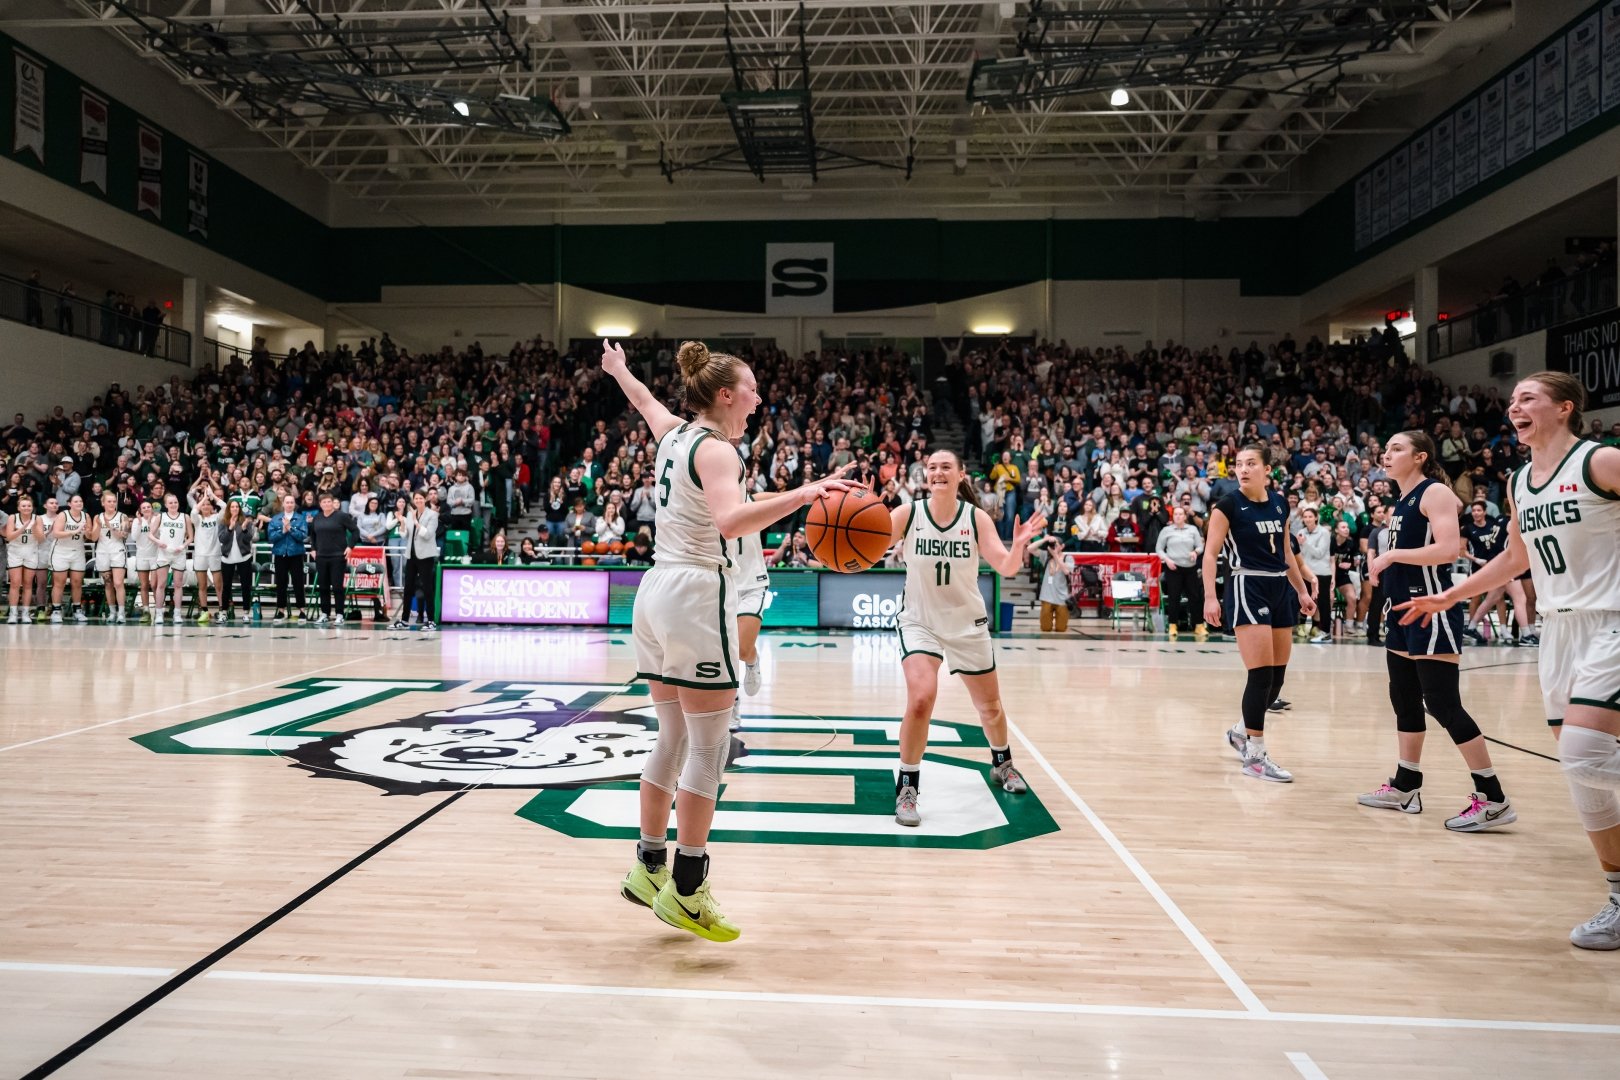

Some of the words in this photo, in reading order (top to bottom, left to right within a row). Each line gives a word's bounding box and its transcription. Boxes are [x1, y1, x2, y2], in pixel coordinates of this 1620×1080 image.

[771, 258, 828, 297] S
[1563, 326, 1599, 355] THAT'S
[1602, 321, 1620, 346] NO
[1569, 347, 1620, 392] HOW
[659, 458, 674, 507] 5
[1255, 520, 1283, 534] UBC
[1520, 499, 1581, 534] USKIES
[22, 535, 28, 544] 0
[105, 530, 111, 540] 4
[169, 528, 175, 538] 9
[1269, 533, 1276, 554] 1
[915, 537, 971, 558] HUSKIES
[1534, 535, 1567, 576] 10
[935, 561, 951, 587] 11
[459, 575, 571, 597] SASKATOON
[459, 597, 589, 619] STARPHOENIX
[852, 616, 898, 628] SASKA
[695, 661, 721, 679] S
